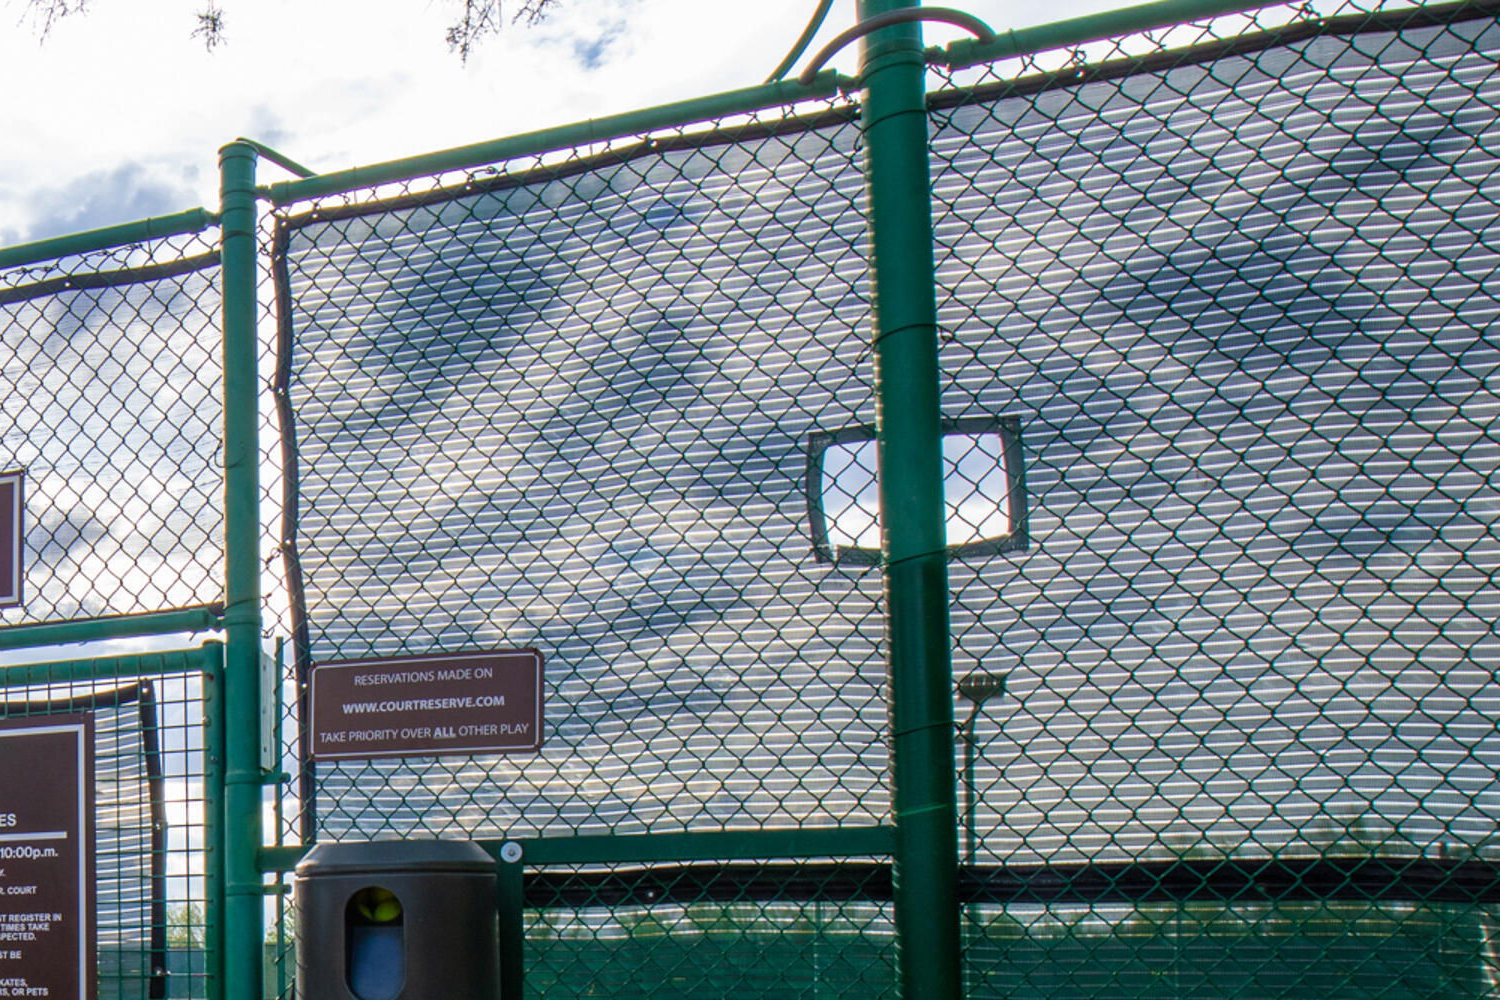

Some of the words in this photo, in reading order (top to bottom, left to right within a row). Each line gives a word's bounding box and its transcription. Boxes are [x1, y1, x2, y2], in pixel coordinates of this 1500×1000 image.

[354, 670, 434, 685] RESERVATIONS
[438, 669, 472, 681] MADE
[474, 668, 493, 679] ON
[343, 696, 505, 714] WWW.COURTRESERVE.COM
[320, 732, 346, 743] TAKE
[349, 729, 398, 741] PRIORITY
[401, 728, 431, 739] OVER
[433, 726, 456, 738] ALL
[459, 725, 497, 737] OTHER
[500, 723, 529, 734] PLAY
[0, 847, 58, 860] 10:00p.m.
[7, 886, 37, 895] COURT
[9, 914, 50, 922] REGISTER
[52, 913, 62, 921] IN
[28, 923, 50, 931] TAKE
[10, 951, 22, 959] BE
[12, 988, 24, 996] OR
[26, 988, 48, 996] PETS
